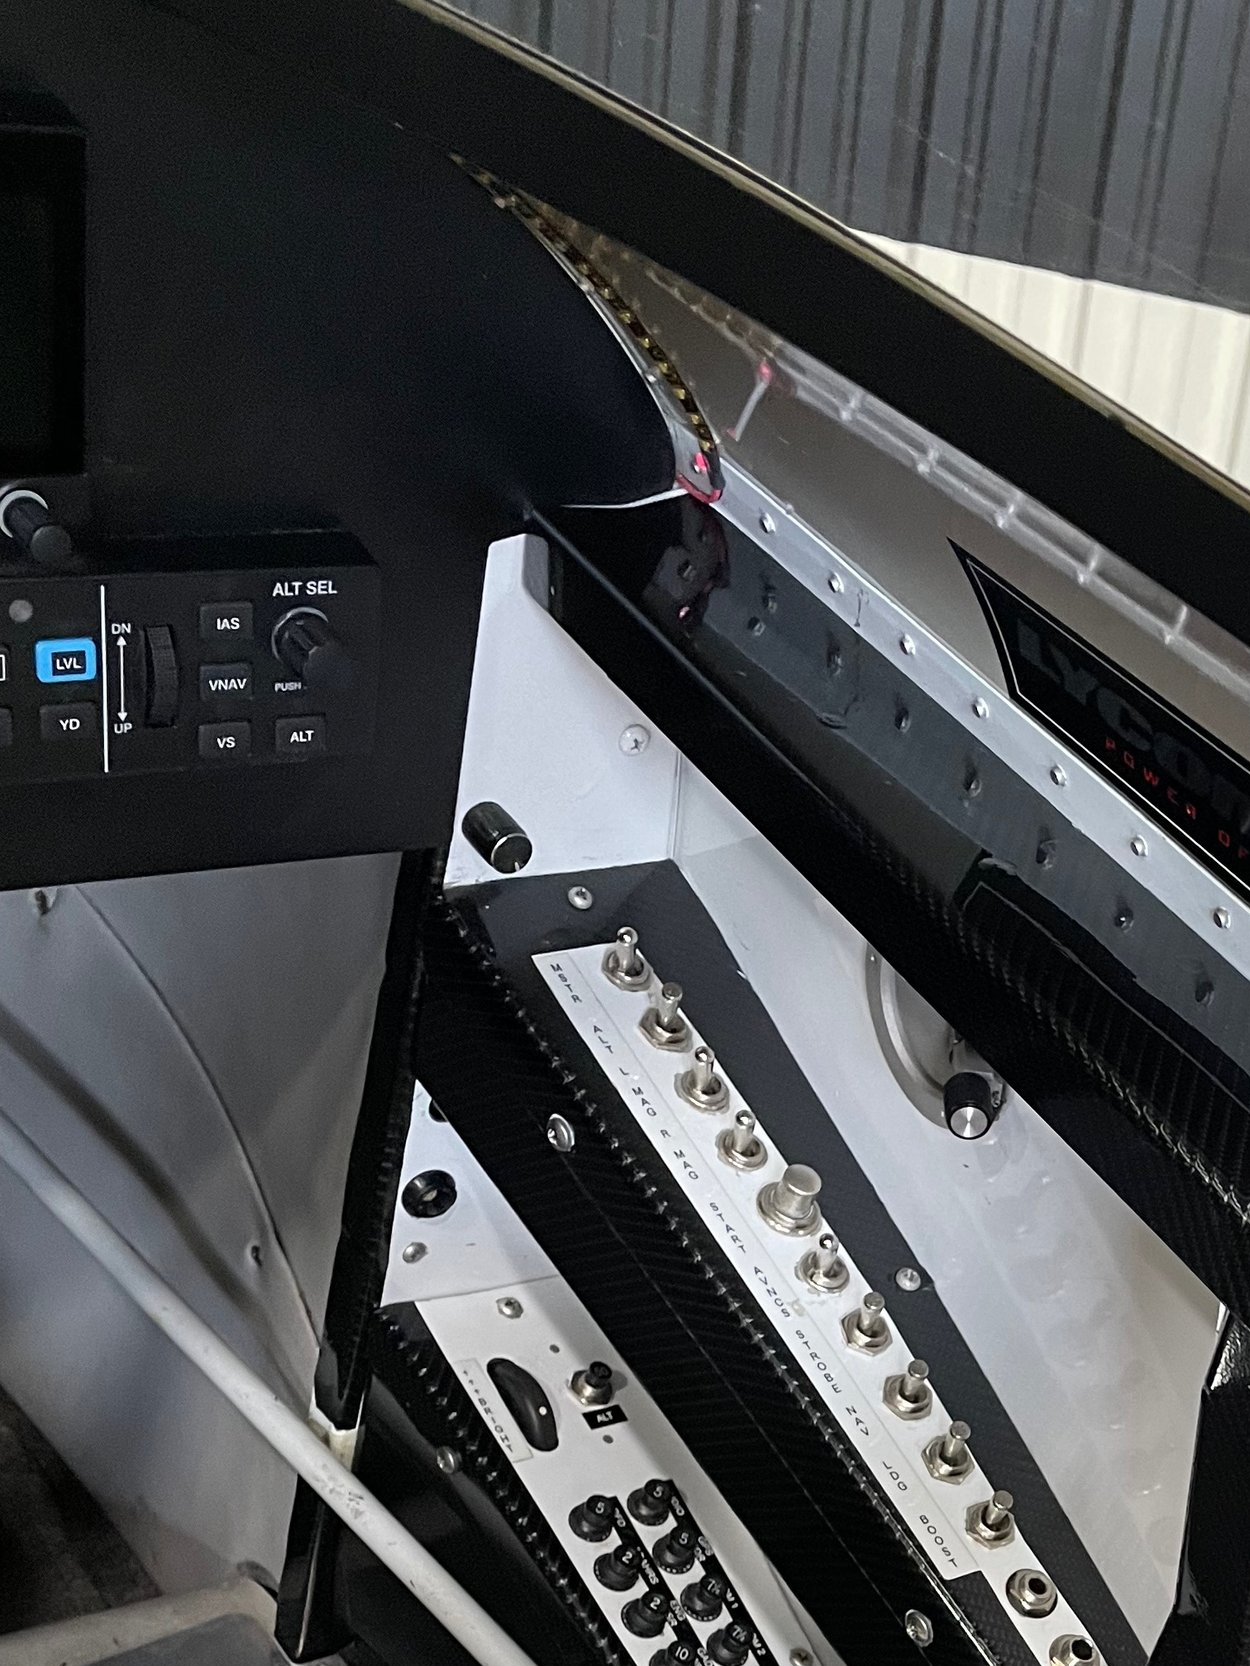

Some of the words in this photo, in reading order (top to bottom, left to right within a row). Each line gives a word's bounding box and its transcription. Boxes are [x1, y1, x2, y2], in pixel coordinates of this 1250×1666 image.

[272, 581, 303, 597] ALT
[306, 580, 338, 595] SEL
[111, 623, 131, 635] DN
[216, 617, 240, 631] IAS
[56, 658, 82, 670] LVL
[208, 677, 247, 692] VNAV
[274, 682, 301, 692] PUSH
[59, 718, 80, 731] YD
[113, 722, 133, 734] UP
[216, 736, 236, 749] VS
[290, 730, 315, 743] ALT
[1105, 735, 1197, 822] POWER
[1217, 828, 1250, 862] OF
[550, 963, 583, 1003] MSTR
[593, 1024, 614, 1055] ALT
[632, 1086, 657, 1117] MAG
[660, 1129, 671, 1139] R
[673, 1149, 699, 1180] MAG
[709, 1201, 747, 1254] START
[795, 1329, 842, 1394] STROBE
[596, 1411, 614, 1424] ALT
[845, 1404, 870, 1437] NAV
[882, 1460, 908, 1492] LDG
[653, 1485, 664, 1498] 5
[595, 1501, 605, 1514] 5
[679, 1532, 689, 1545] 5
[919, 1513, 959, 1569] BOOST
[622, 1551, 633, 1564] 2
[650, 1597, 661, 1610] 2
[675, 1646, 689, 1660] 10
